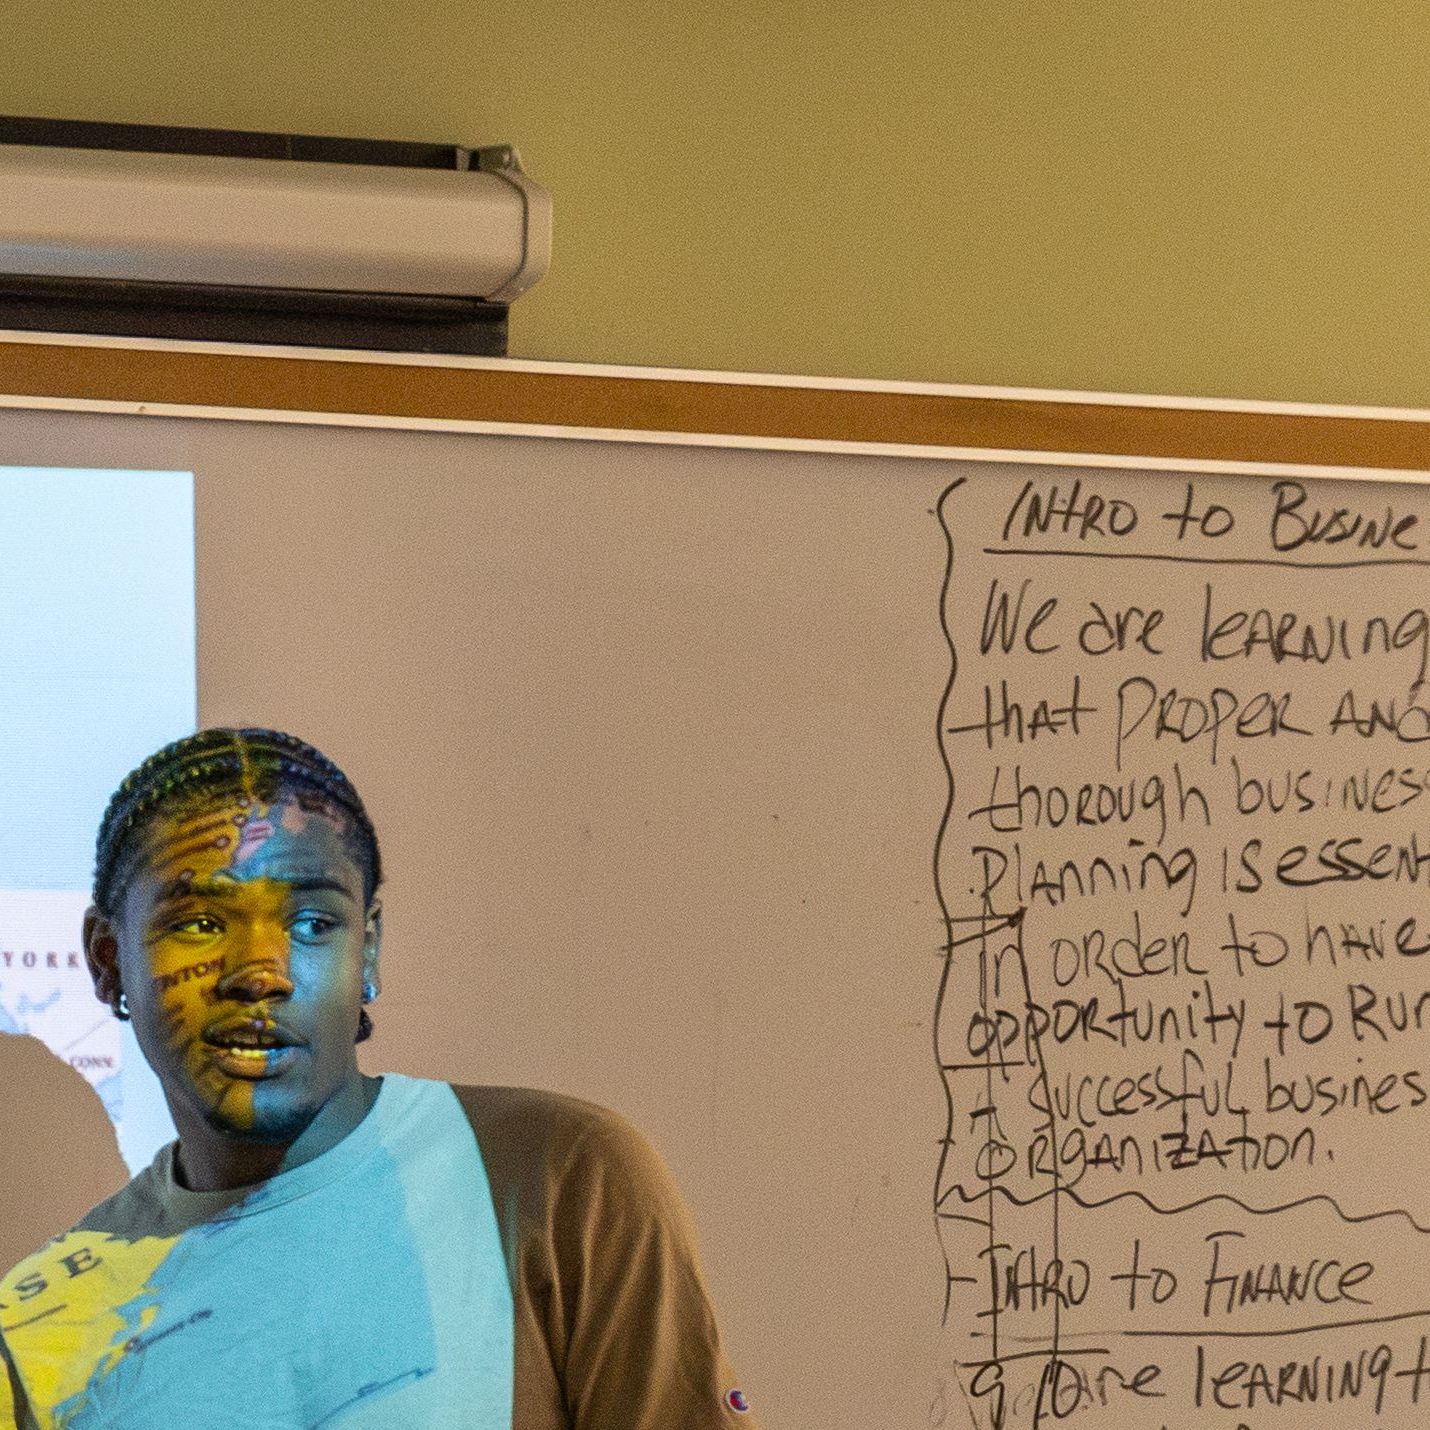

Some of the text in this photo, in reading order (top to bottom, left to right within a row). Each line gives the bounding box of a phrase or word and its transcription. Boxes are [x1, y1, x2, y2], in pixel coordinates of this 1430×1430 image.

[1162, 482, 1236, 540] to
[980, 578, 1060, 657] We
[1077, 600, 1167, 656] are
[2, 950, 80, 969] YORK
[1220, 912, 1290, 977] to
[1263, 991, 1334, 1057] to
[1110, 1238, 1178, 1312] to
